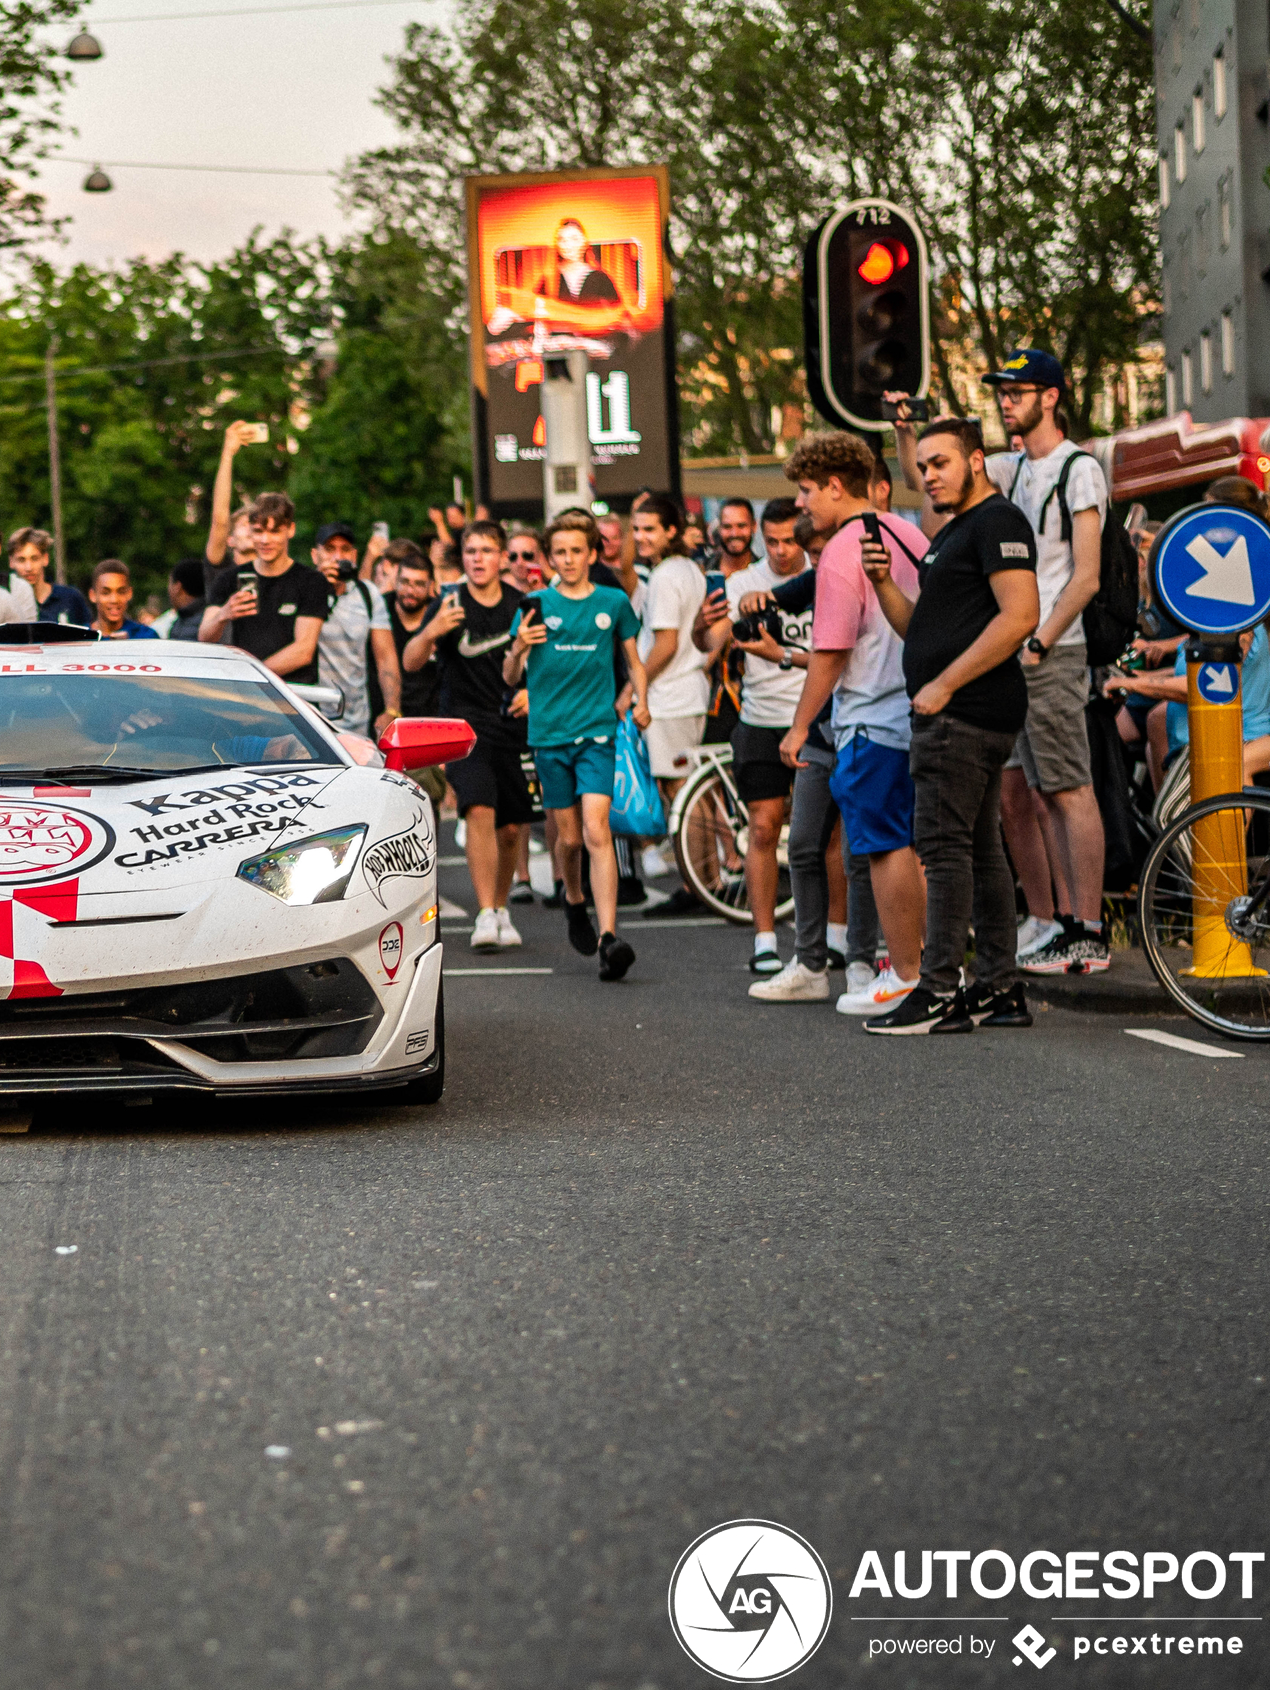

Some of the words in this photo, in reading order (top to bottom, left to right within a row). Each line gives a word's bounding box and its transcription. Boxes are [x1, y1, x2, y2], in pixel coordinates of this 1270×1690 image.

[62, 664, 162, 672] 3000
[123, 774, 325, 817] Kappa
[129, 809, 227, 843] Hard
[225, 794, 325, 819] Rock
[114, 816, 307, 868] CARRERA
